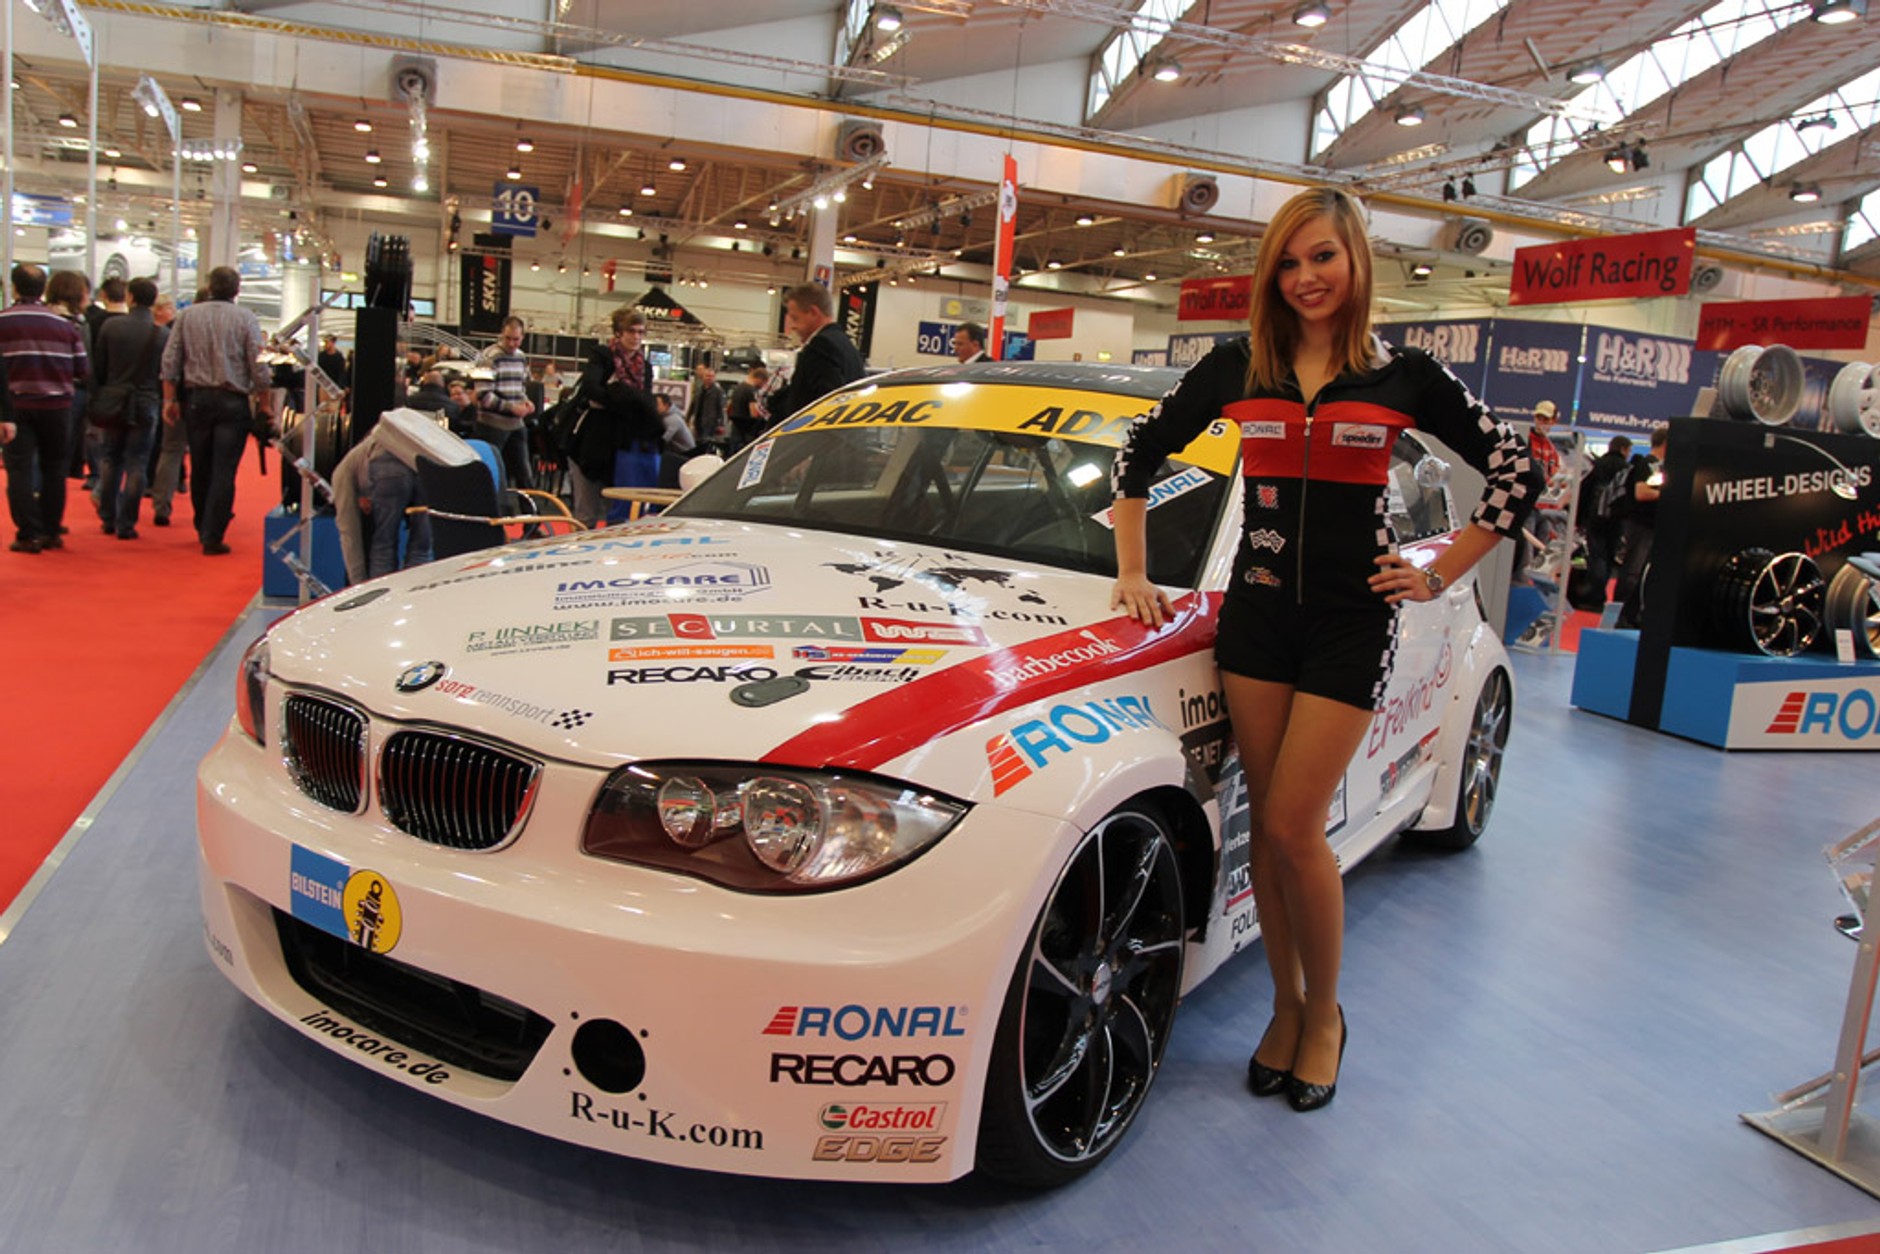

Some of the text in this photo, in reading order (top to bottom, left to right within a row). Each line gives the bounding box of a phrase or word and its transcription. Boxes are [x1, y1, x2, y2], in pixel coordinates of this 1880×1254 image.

[499, 189, 534, 222] 10
[1523, 252, 1680, 292] Wolf Racing
[482, 271, 496, 312] SKN
[1773, 315, 1863, 332] Performance
[920, 334, 941, 353] 9.0
[809, 400, 943, 427] ADAC
[1018, 407, 1128, 438] ADA
[1210, 422, 1227, 436] 5
[1147, 471, 1204, 508] ONAL
[1804, 519, 1853, 558] Wild
[557, 573, 741, 592] IMOCARE
[858, 596, 1069, 627] R-u-K.com
[617, 619, 856, 638] SECURTAL
[984, 629, 1123, 689] barbecook
[607, 666, 778, 686] RECARO
[434, 679, 556, 724] sorg rennsport
[1799, 687, 1880, 741] RO
[292, 872, 342, 910] BILSTEIN
[797, 1005, 966, 1041] RONAL
[300, 1010, 450, 1084] imocare.de
[770, 1053, 956, 1087] RECARO
[570, 1091, 764, 1151] R-u-K.com
[848, 1106, 936, 1130] Castrol
[812, 1136, 948, 1164] EDGE
